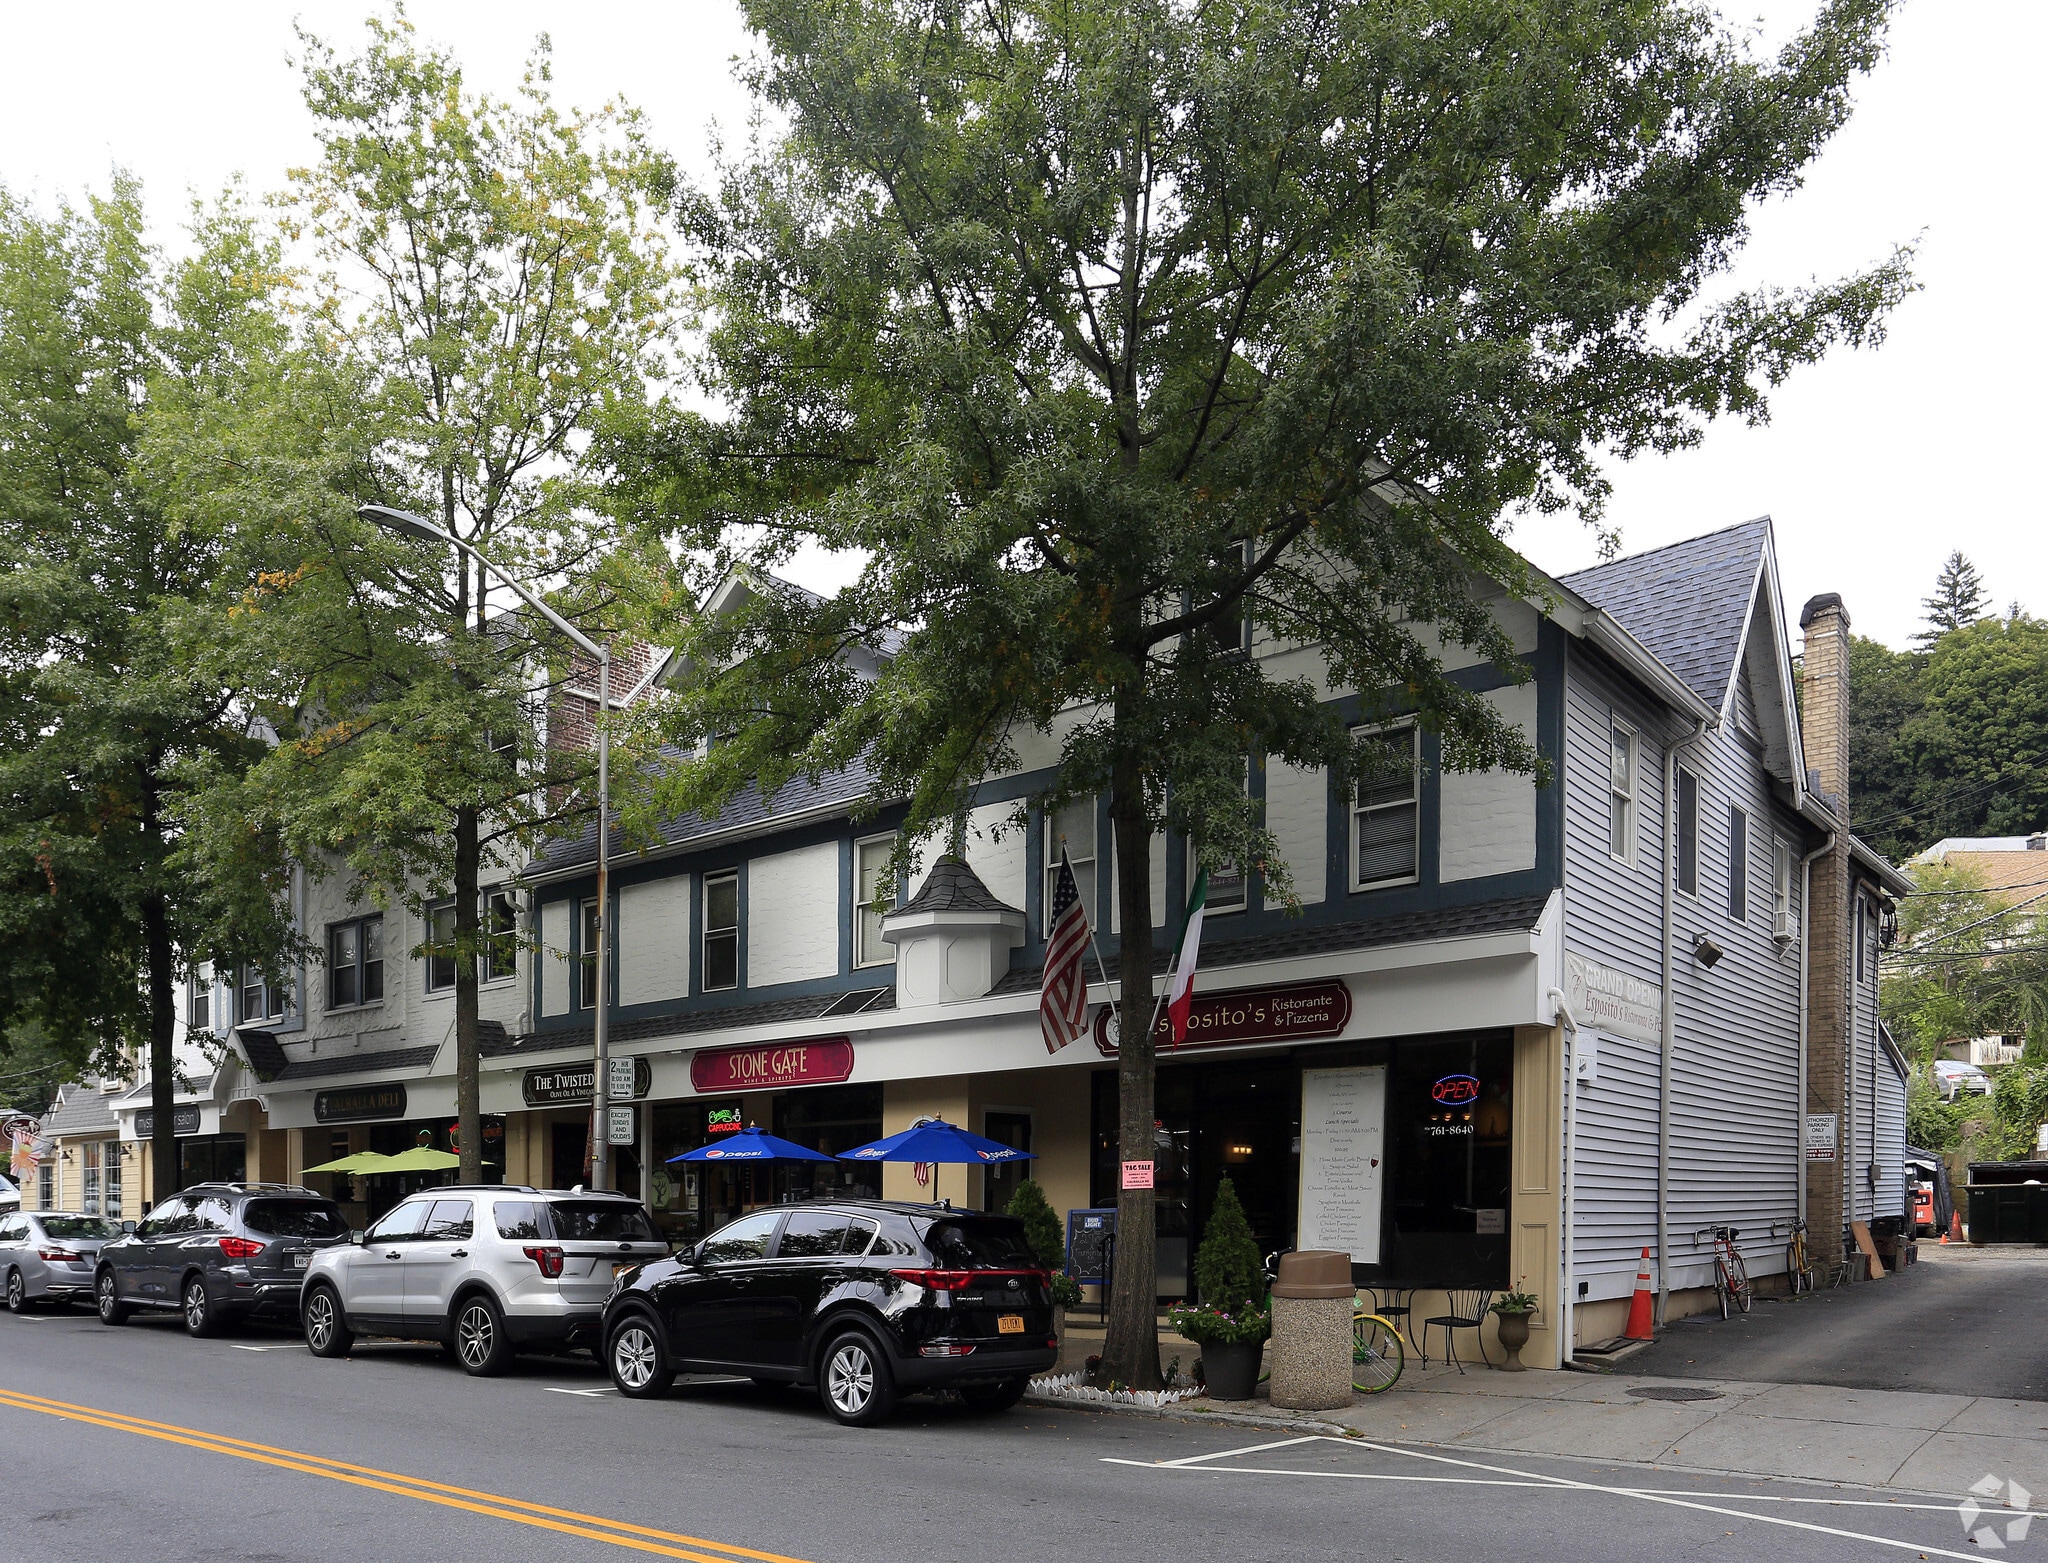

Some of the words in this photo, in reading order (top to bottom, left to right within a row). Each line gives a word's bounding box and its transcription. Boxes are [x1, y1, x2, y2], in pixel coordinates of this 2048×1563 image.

[1585, 964, 1623, 997] GRAND
[1627, 981, 1662, 1010] OPENI
[1272, 995, 1332, 1012] Ristorante
[1585, 990, 1623, 1023] Esposito's
[1274, 1015, 1284, 1026] &
[1286, 1011, 1329, 1026] Pizzeria
[611, 1062, 617, 1073] 2
[729, 1052, 768, 1079] STONE
[771, 1048, 807, 1076] GATE
[534, 1076, 552, 1090] THE
[554, 1073, 595, 1089] TWISTED
[550, 1090, 562, 1098] OLIVE
[562, 1089, 570, 1097] OIL
[571, 1089, 576, 1097] &
[1432, 1081, 1480, 1099] OPEN
[378, 1092, 399, 1107] DELI
[177, 1111, 195, 1126] salon
[1431, 1125, 1474, 1136] 761-8640
[989, 1149, 1017, 1160] pepsi
